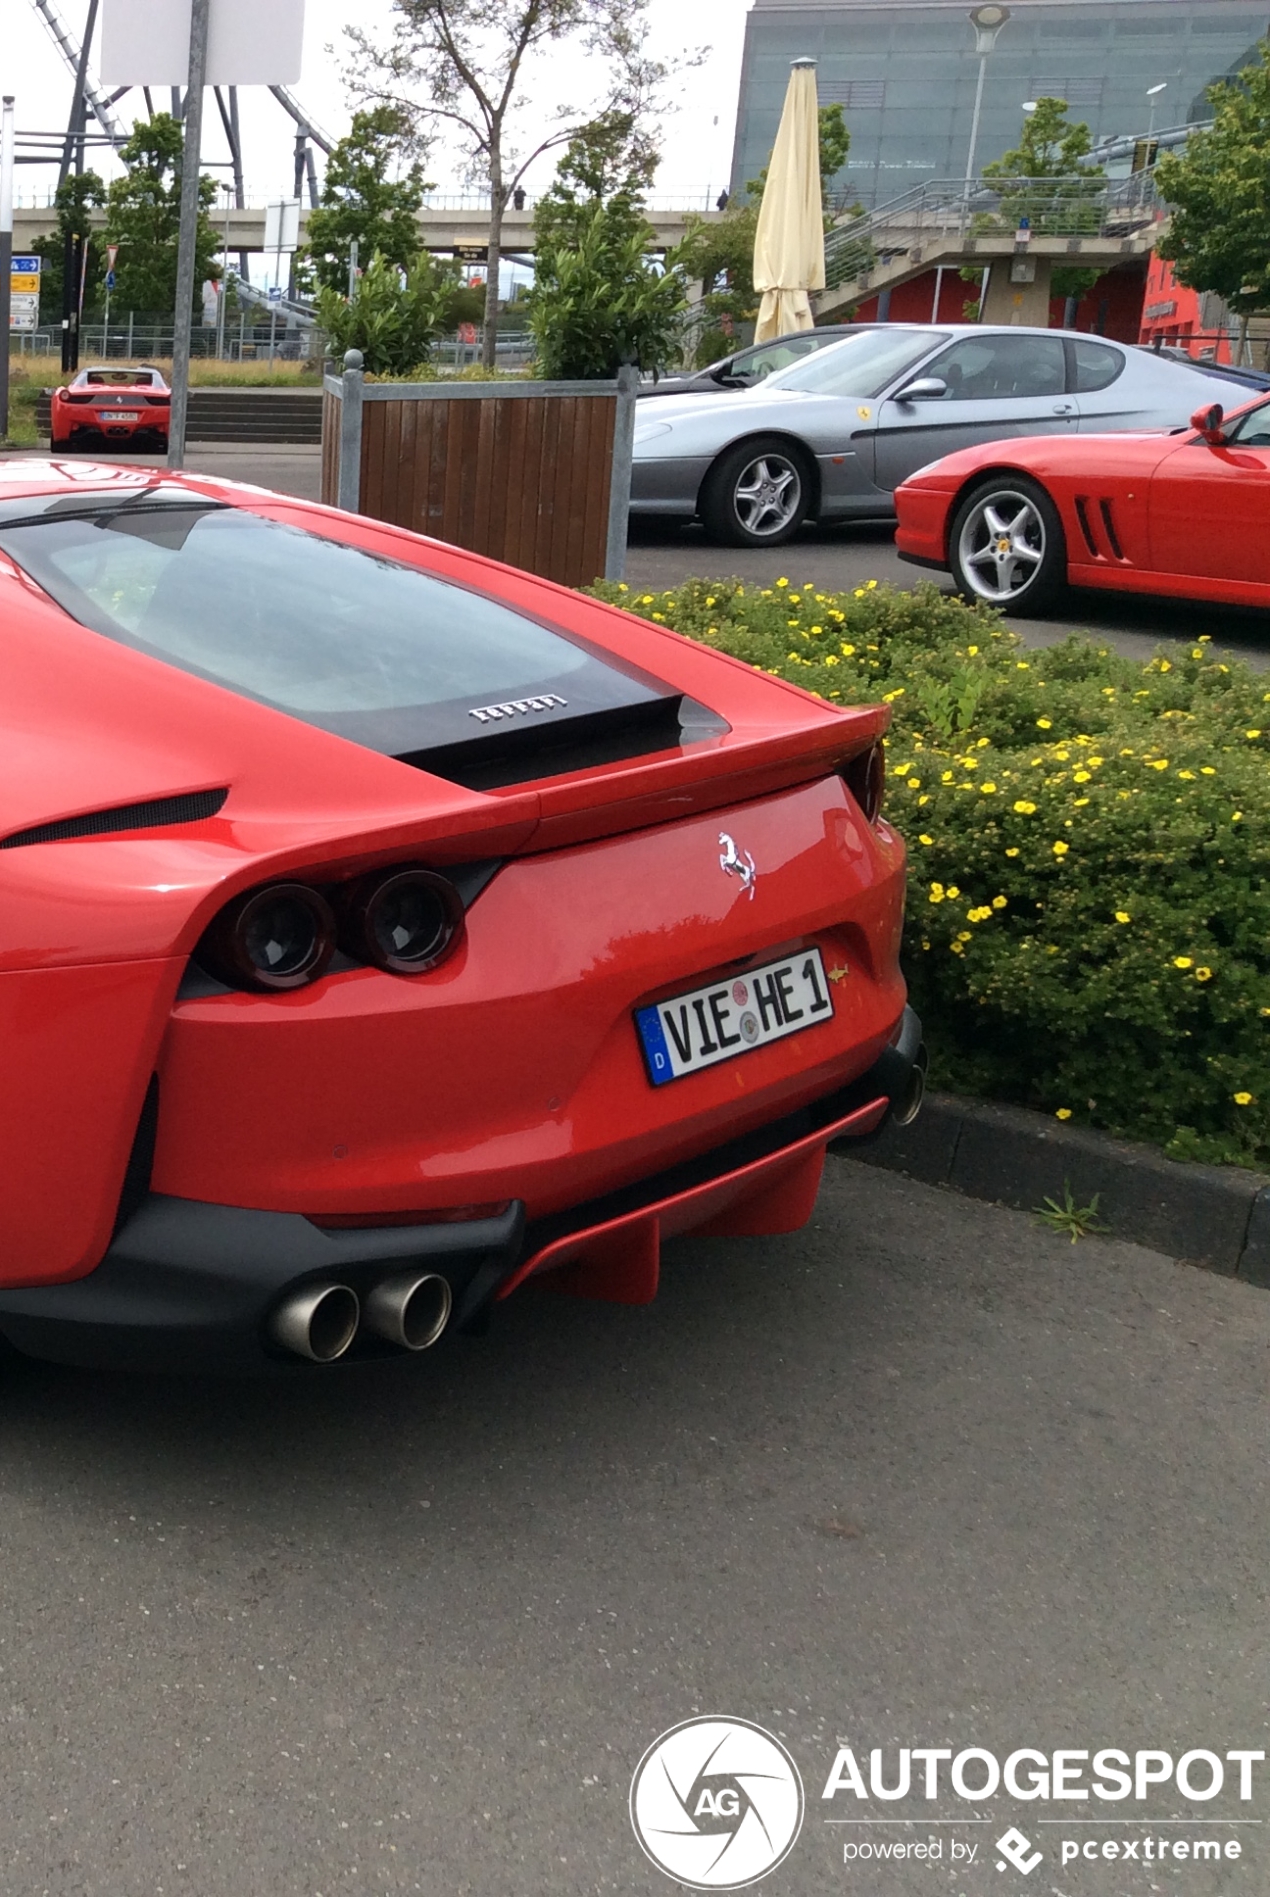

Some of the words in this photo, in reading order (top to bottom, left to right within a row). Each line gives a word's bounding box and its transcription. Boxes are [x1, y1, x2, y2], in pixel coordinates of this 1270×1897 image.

[468, 694, 568, 724] Ferrari
[663, 990, 741, 1063] VIE
[753, 966, 804, 1032] HE
[802, 958, 828, 1013] 1
